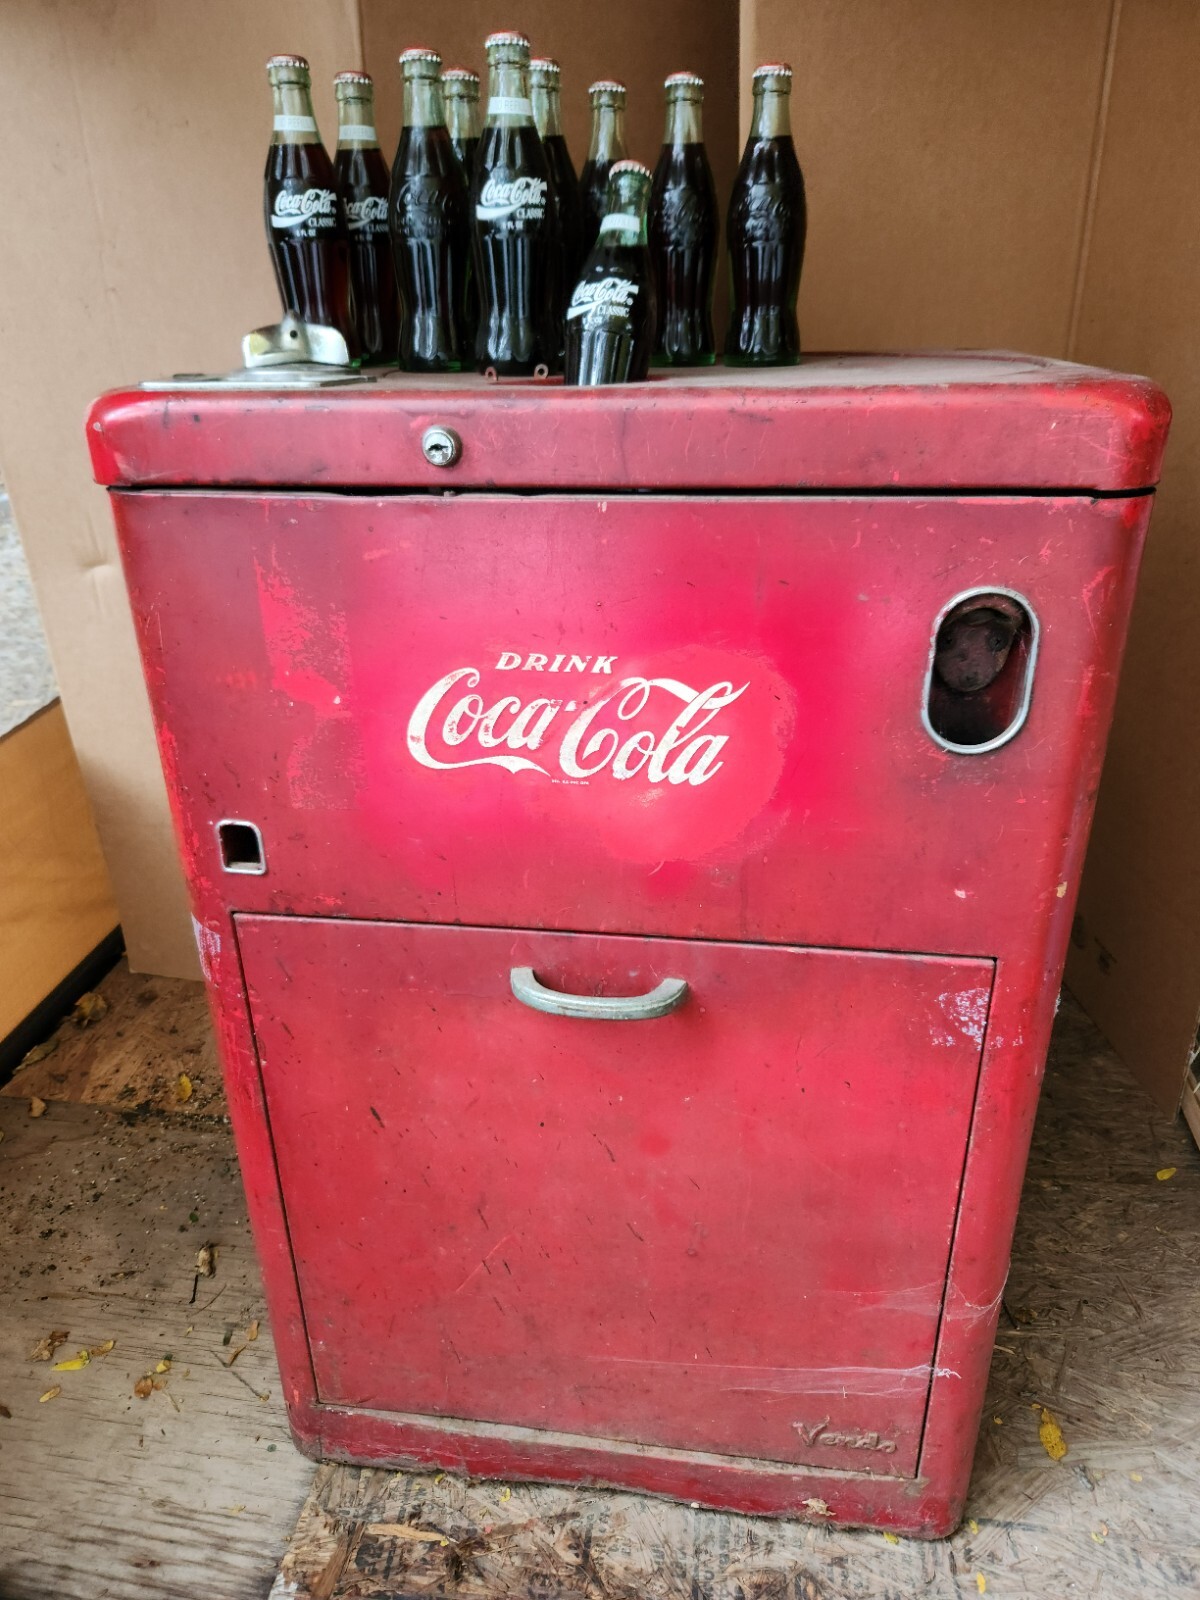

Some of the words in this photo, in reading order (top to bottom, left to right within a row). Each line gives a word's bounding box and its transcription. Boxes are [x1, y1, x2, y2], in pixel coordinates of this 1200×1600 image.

[274, 188, 336, 215] Coca-Cola
[480, 176, 547, 206] Coca-Cola
[571, 277, 639, 306] Coca-Cola
[495, 652, 618, 675] DRINK
[406, 667, 751, 787] Coca-Cola
